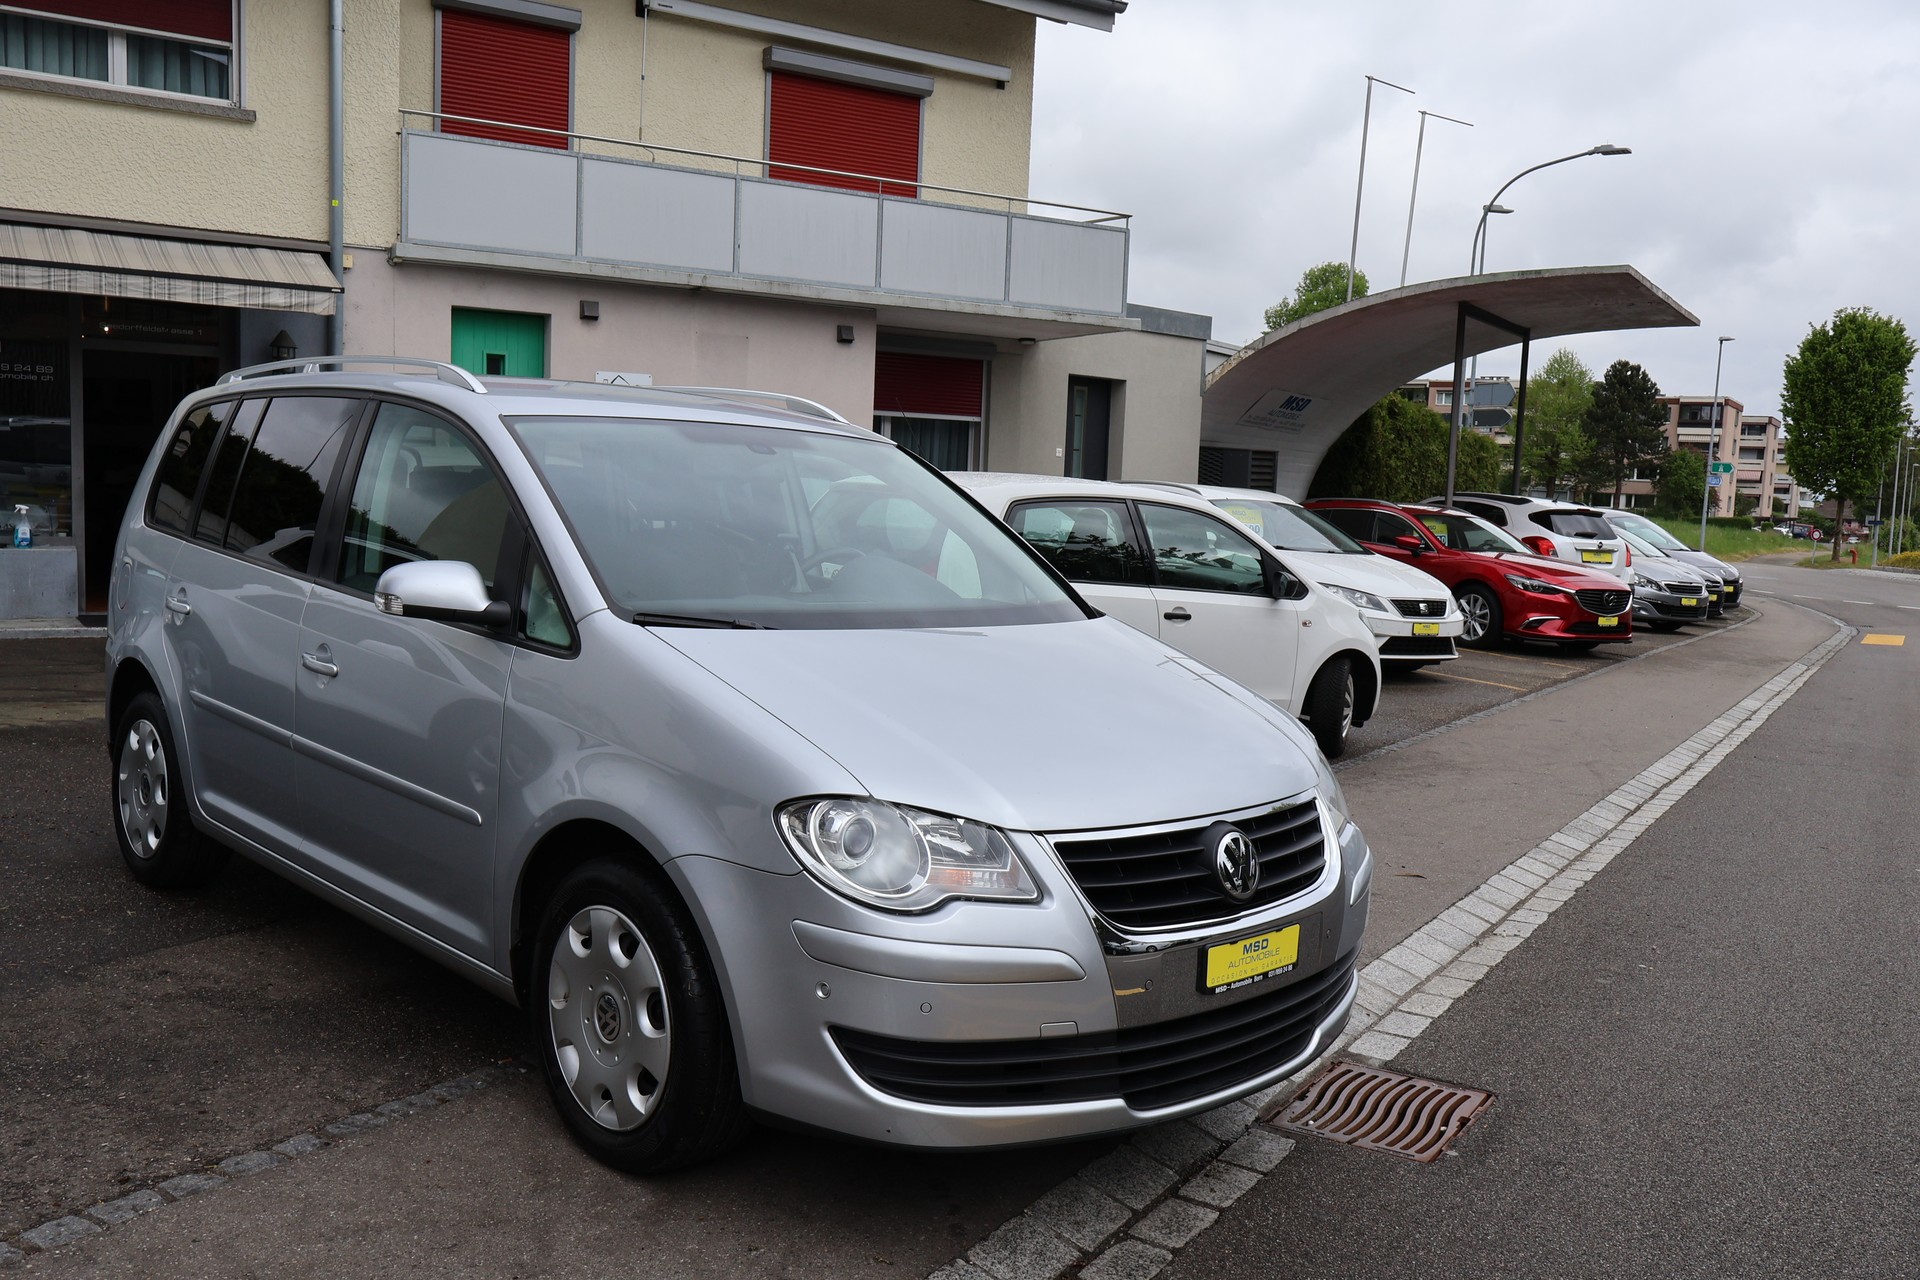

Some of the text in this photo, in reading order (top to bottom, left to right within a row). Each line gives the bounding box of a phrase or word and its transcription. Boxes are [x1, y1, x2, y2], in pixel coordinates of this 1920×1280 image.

[14, 363, 31, 372] 24
[36, 364, 54, 374] 89
[1279, 395, 1312, 412] MSD
[1243, 938, 1269, 955] MSD
[1227, 947, 1281, 970] AUTOMOBILE
[1211, 968, 1248, 985] OCCASION
[1262, 955, 1293, 970] GARANTIE
